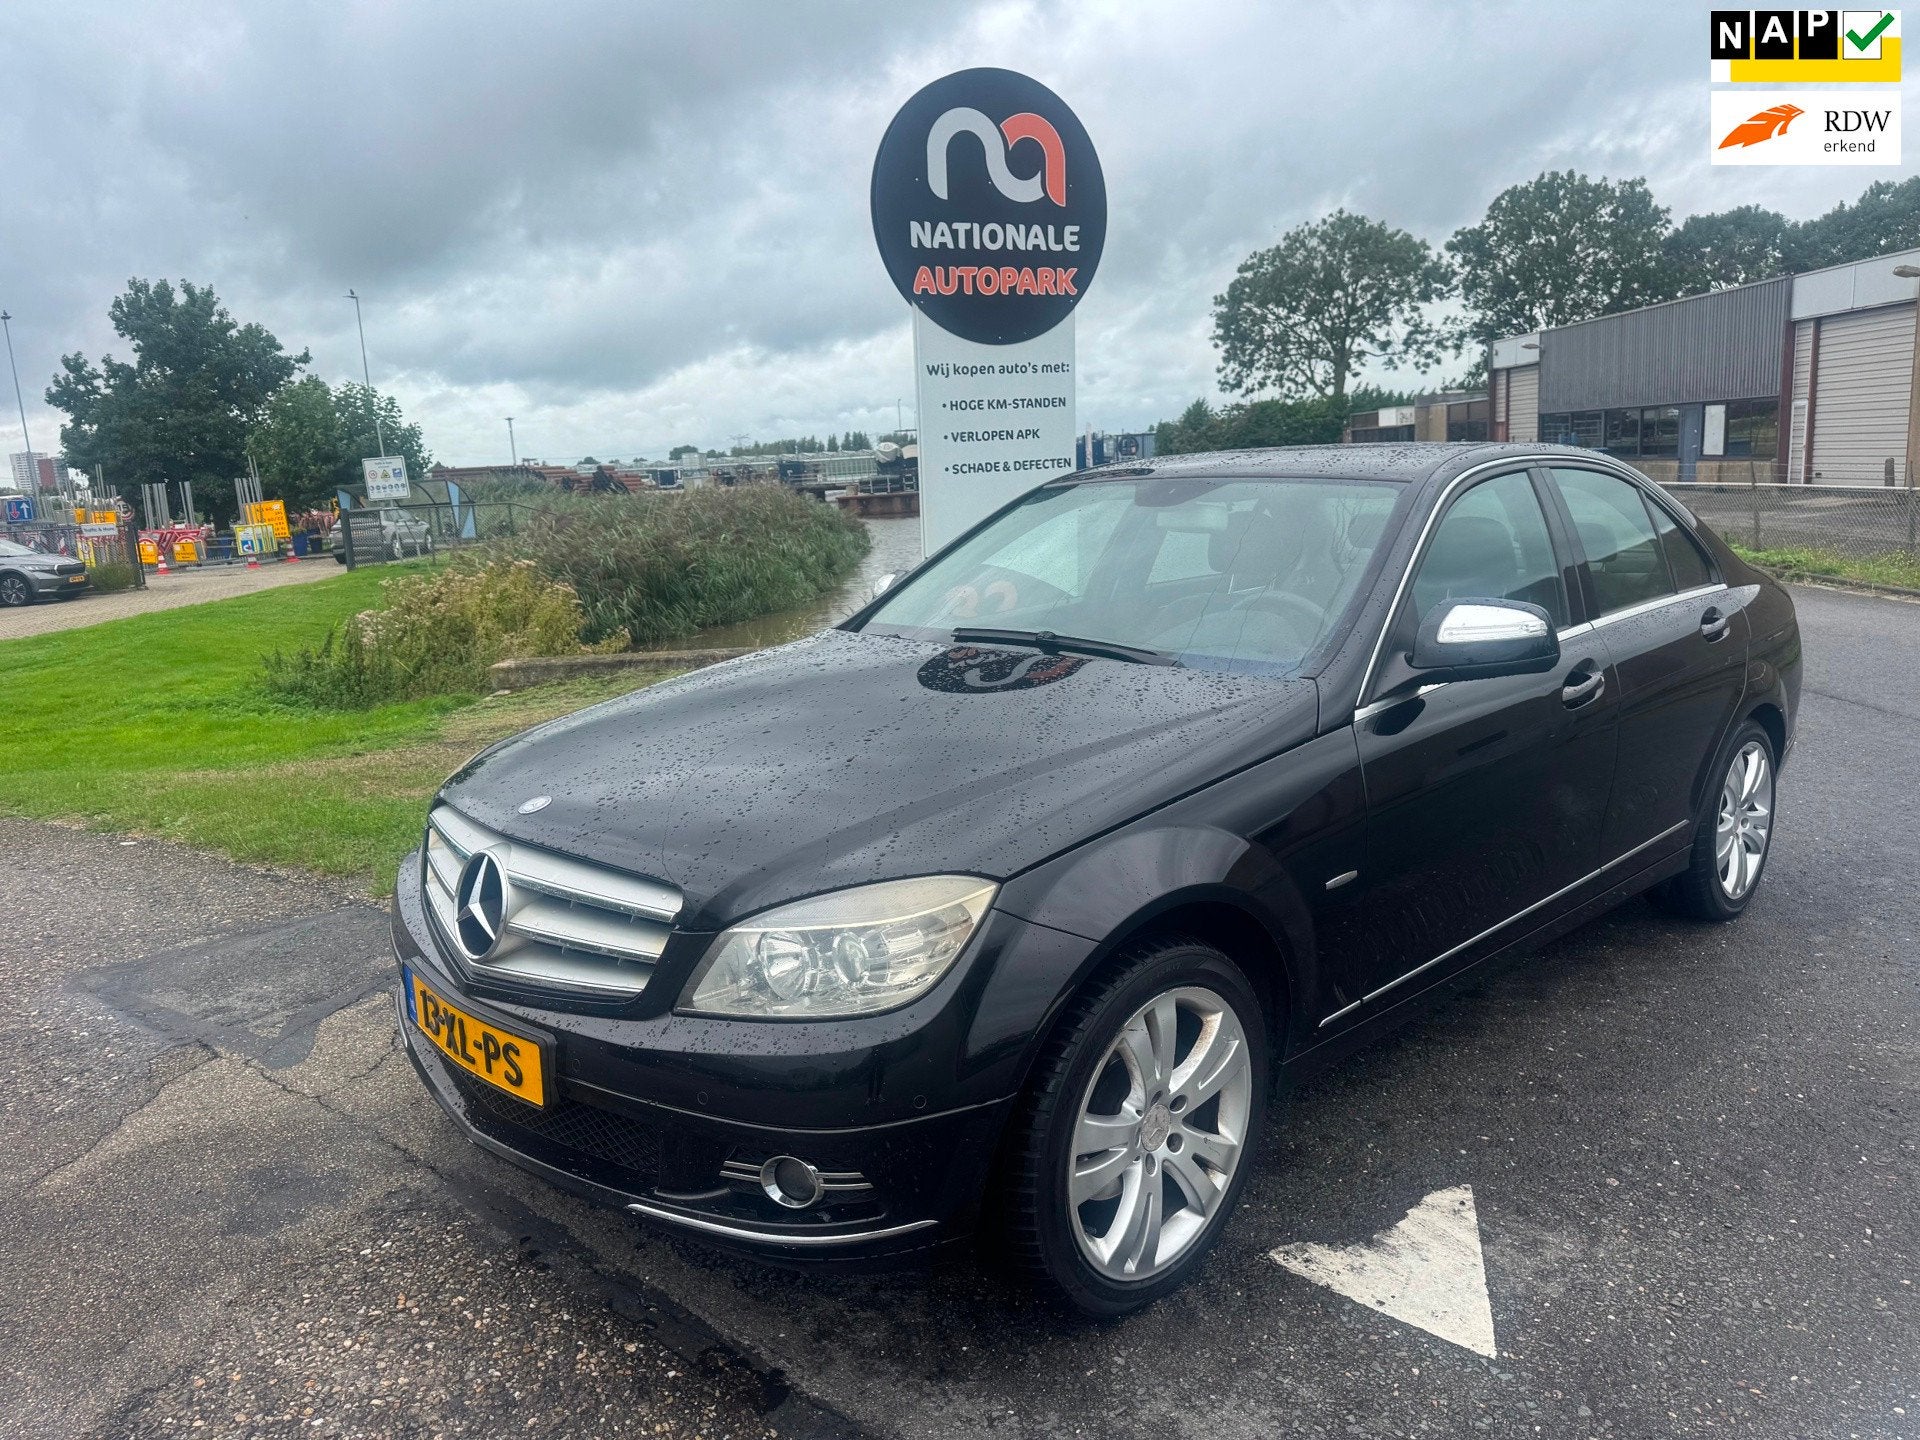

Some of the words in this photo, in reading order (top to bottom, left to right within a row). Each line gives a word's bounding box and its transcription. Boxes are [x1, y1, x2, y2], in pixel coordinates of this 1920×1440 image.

[909, 220, 1080, 252] NATIONALE
[912, 265, 1079, 296] AUTOPARK
[926, 363, 950, 379] Wij
[953, 362, 996, 378] kopen
[998, 361, 1039, 375] auto's
[1041, 361, 1070, 374] met:
[949, 399, 985, 411] HOGE
[987, 397, 1067, 410] KM-STANDEN
[951, 429, 1014, 443] VERLOPEN
[1016, 428, 1041, 440] APK
[952, 461, 1000, 475] SCHADE
[1002, 460, 1012, 472] &
[1013, 457, 1073, 472] DEFECTEN
[420, 988, 524, 1088] 13-XL-PS
